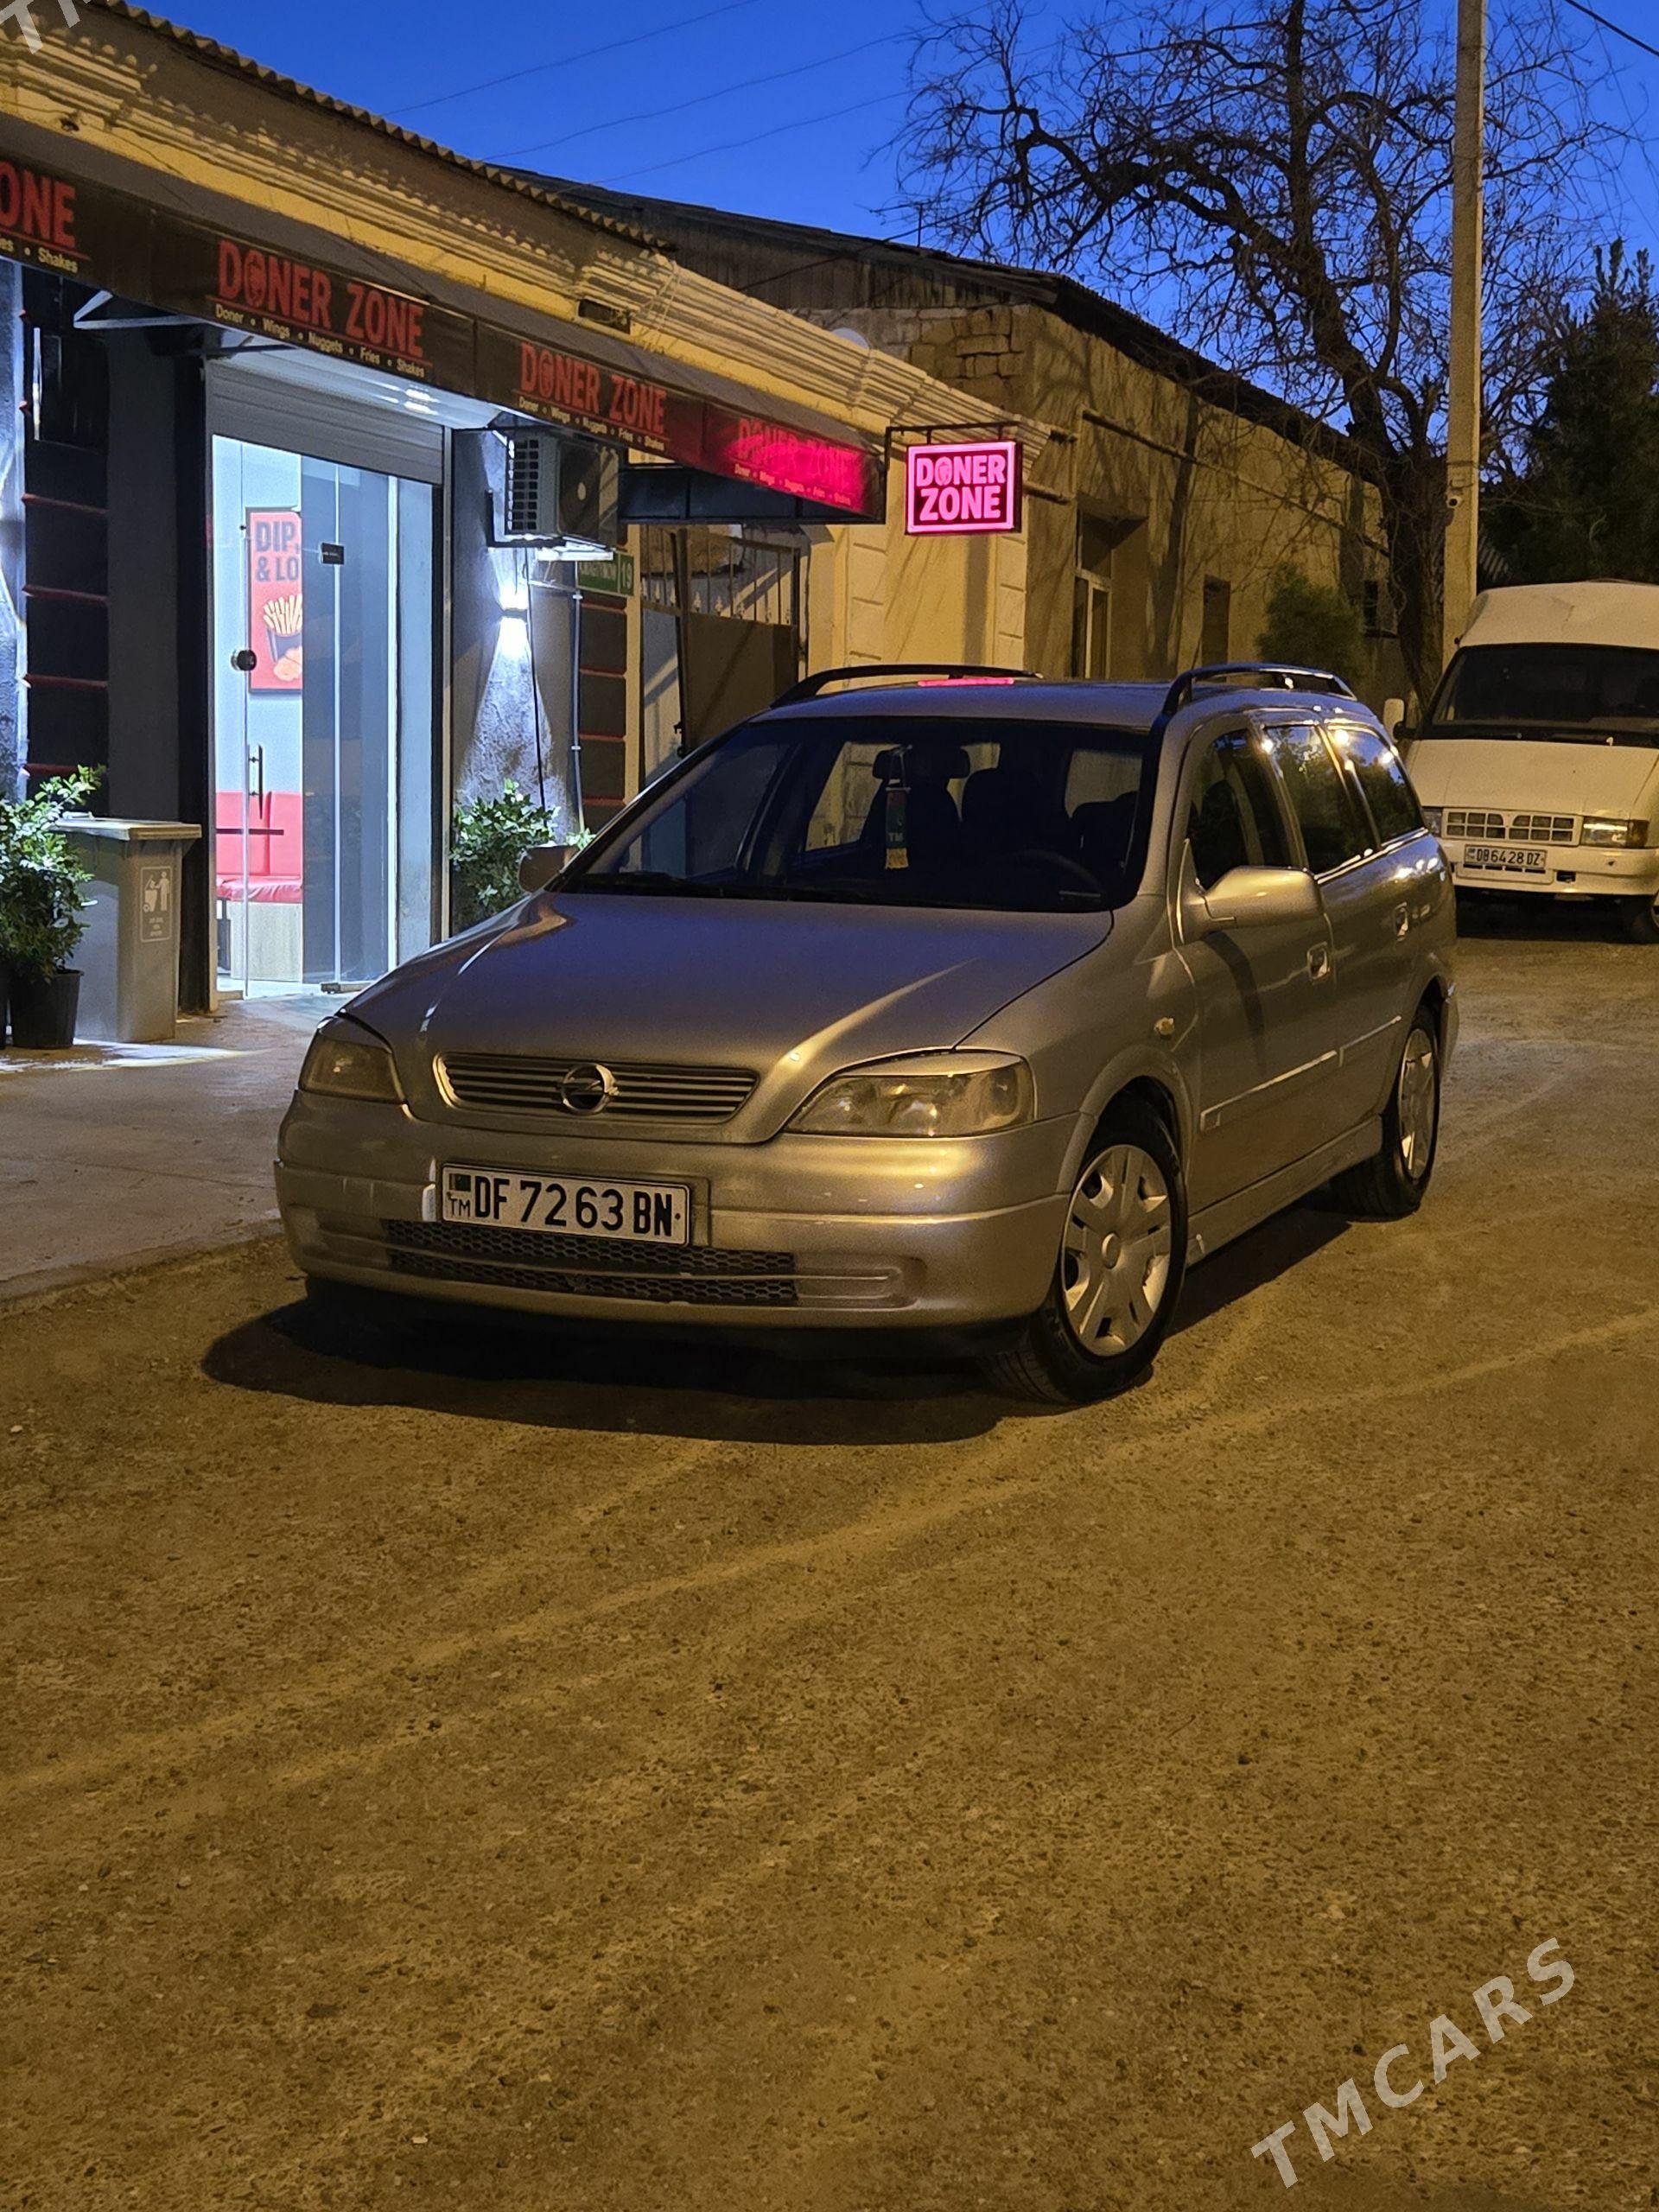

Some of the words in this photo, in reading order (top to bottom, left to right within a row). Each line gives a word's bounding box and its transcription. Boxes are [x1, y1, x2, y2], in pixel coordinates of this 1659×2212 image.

[218, 238, 332, 330] DONER
[346, 282, 424, 358] ZONE
[215, 303, 245, 325] Doner
[263, 318, 290, 340] Wings
[308, 334, 344, 354] Nuggets
[359, 347, 381, 365] Fries
[396, 358, 426, 378] Shakes
[521, 340, 601, 415] DONER
[609, 373, 667, 435] ZONE
[916, 454, 1006, 487] DONER
[918, 485, 1001, 522] ZONE
[449, 1196, 472, 1217] TM
[474, 1175, 510, 1220] DF
[632, 1191, 672, 1236] BN
